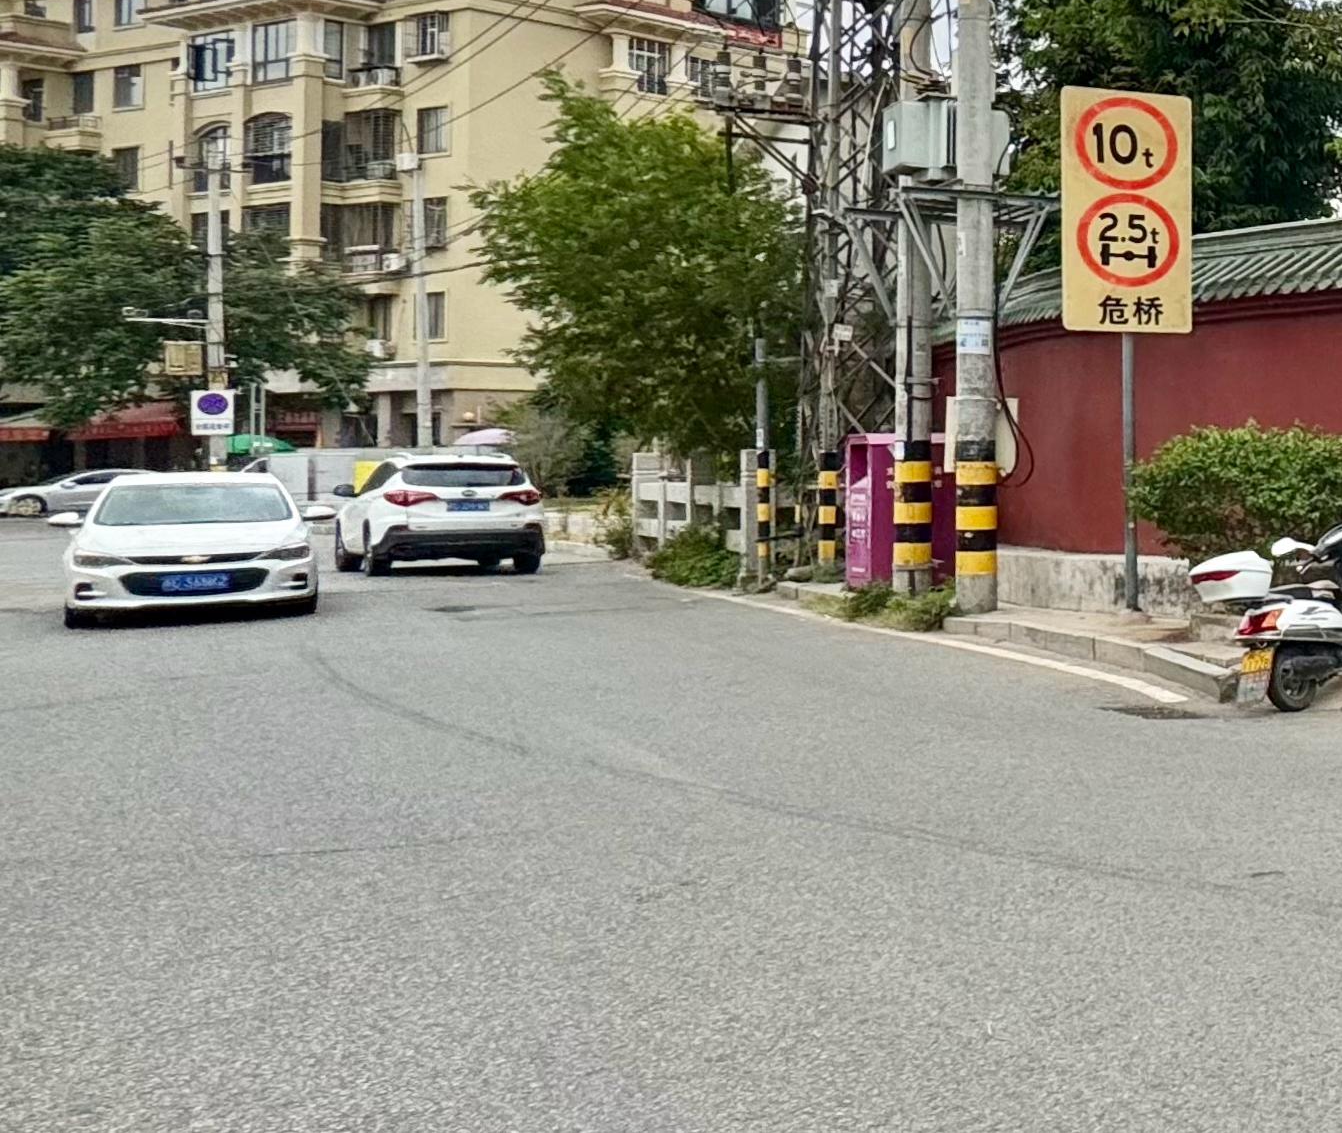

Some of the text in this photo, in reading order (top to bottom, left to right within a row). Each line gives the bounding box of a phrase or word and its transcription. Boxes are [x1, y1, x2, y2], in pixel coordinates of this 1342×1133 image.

[1093, 122, 1154, 168] 10t
[1099, 212, 1160, 246] 2.5t
[1098, 295, 1164, 326] 危桥
